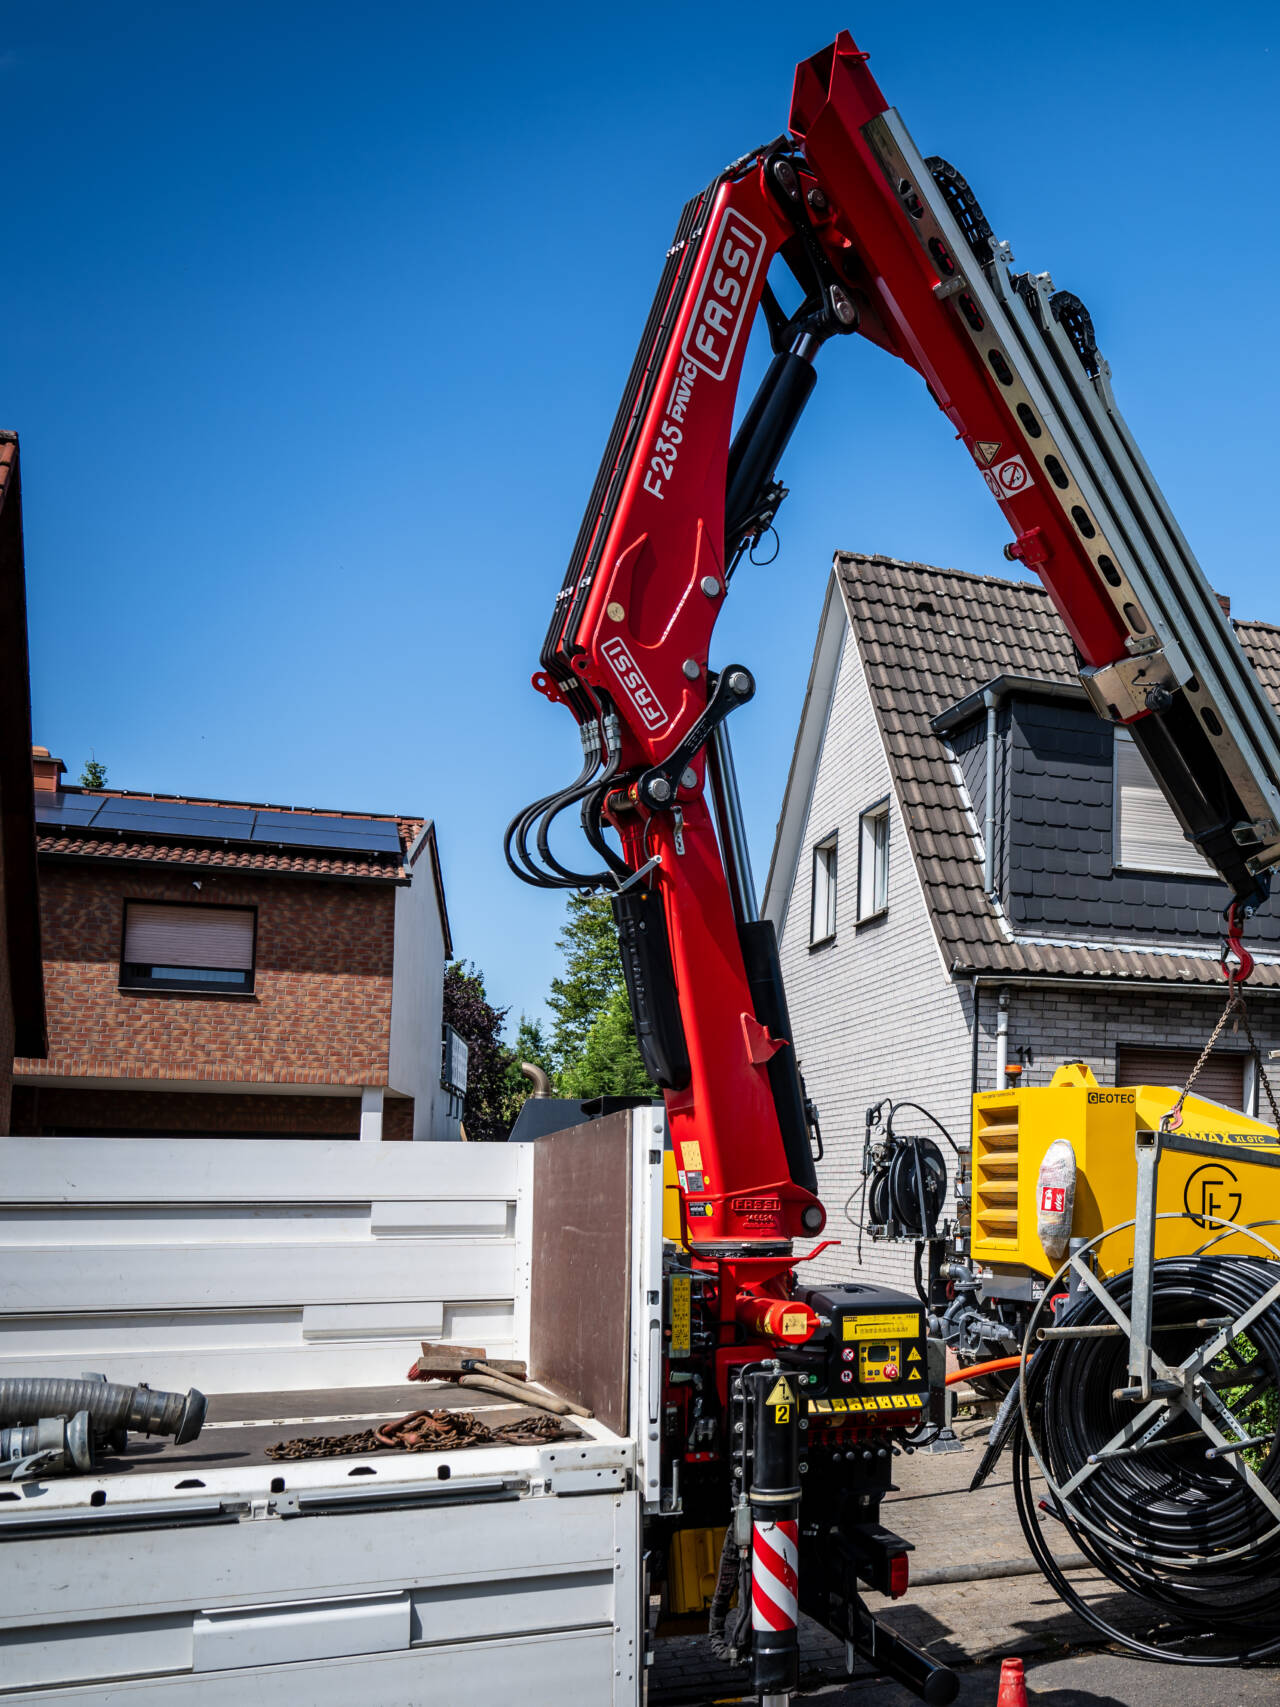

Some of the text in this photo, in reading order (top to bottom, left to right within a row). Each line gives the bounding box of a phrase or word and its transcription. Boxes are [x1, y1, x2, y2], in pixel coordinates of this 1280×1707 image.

[695, 226, 756, 363] FASSI
[643, 421, 684, 501] F235
[608, 645, 661, 721] FASSI
[1015, 1046, 1032, 1066] 11
[1087, 1092, 1135, 1104] GEOTEC
[1234, 1135, 1248, 1143] XL
[1248, 1135, 1265, 1143] GTC
[777, 1406, 788, 1422] 2
